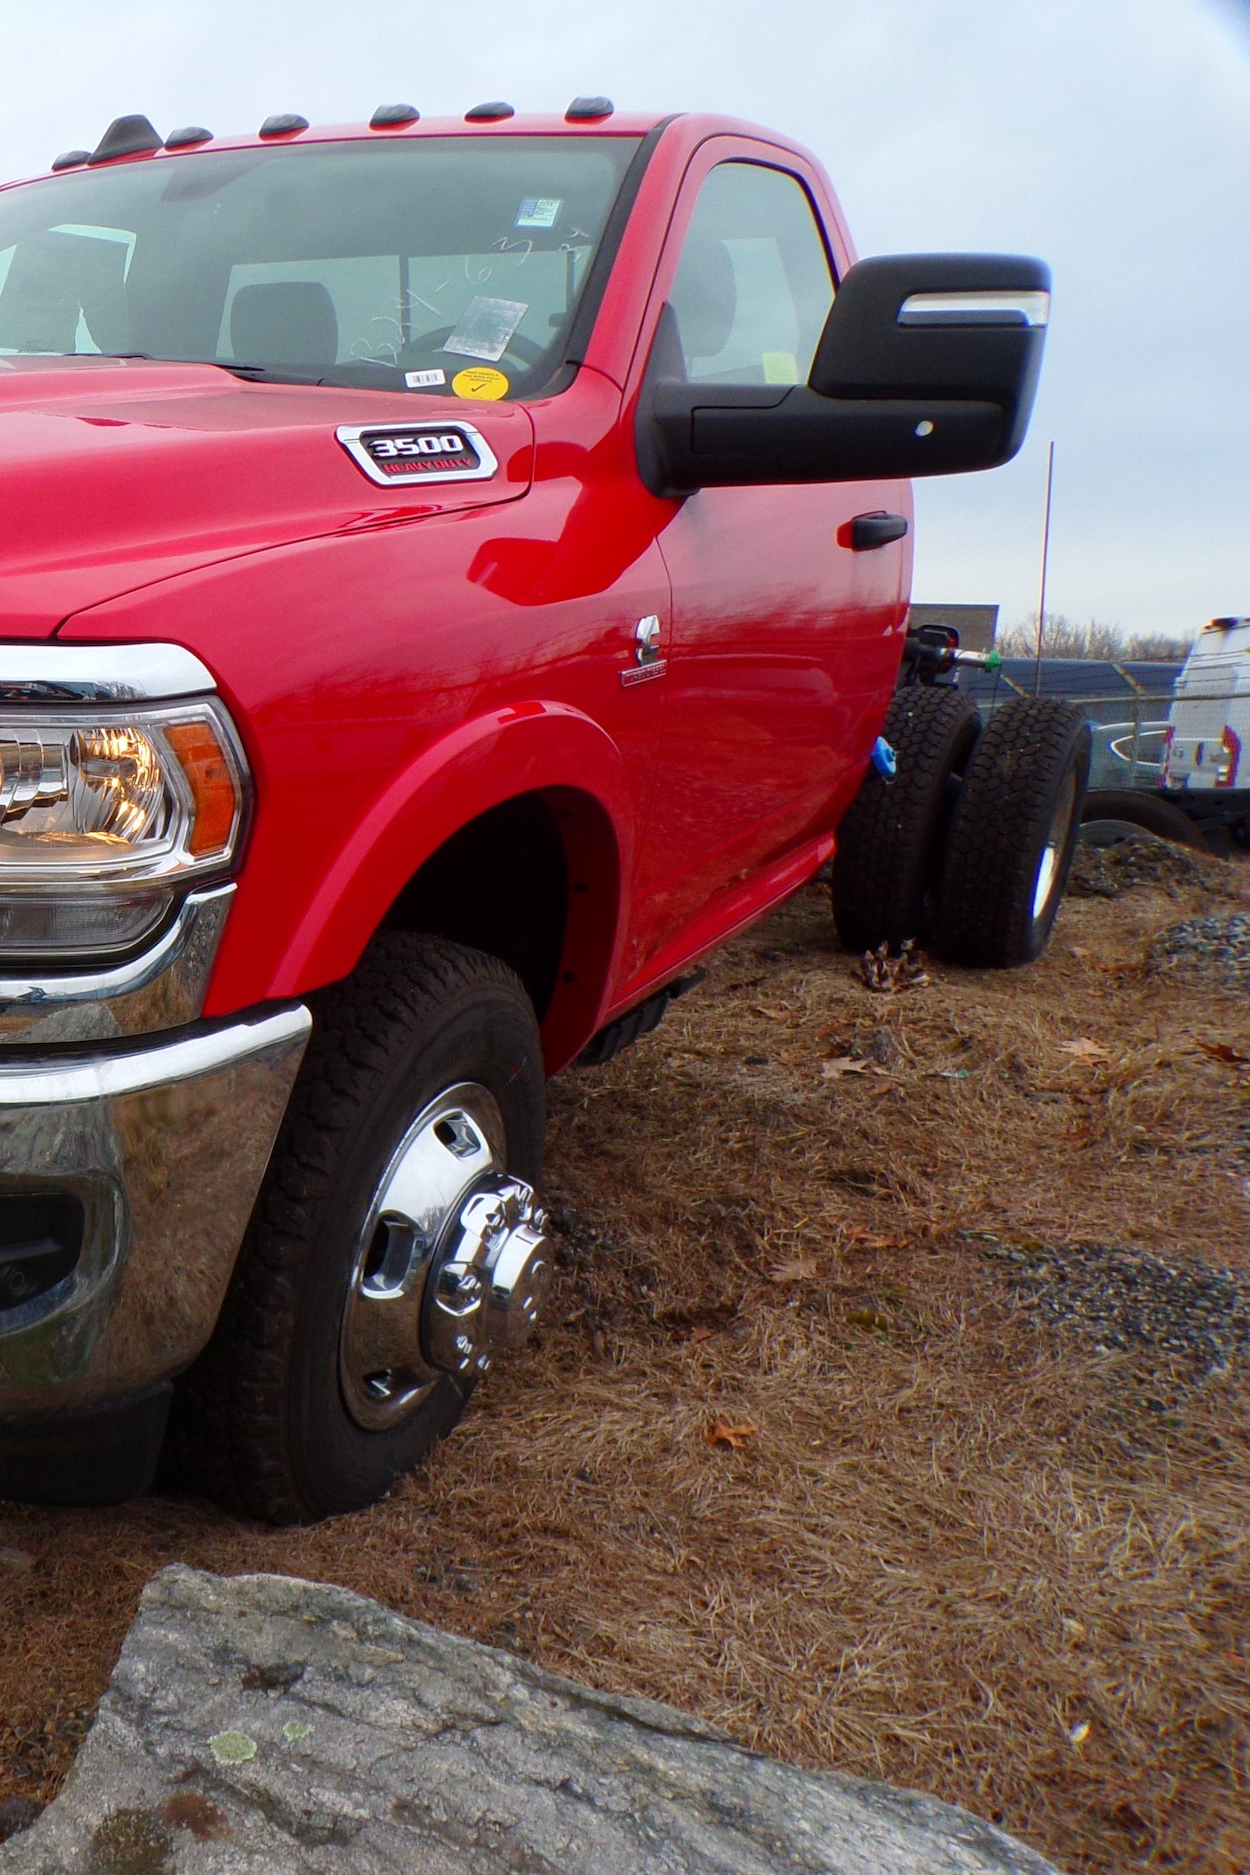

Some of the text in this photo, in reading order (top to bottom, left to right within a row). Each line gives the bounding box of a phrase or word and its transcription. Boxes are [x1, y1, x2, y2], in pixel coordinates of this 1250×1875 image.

[370, 435, 464, 458] 3500
[384, 458, 472, 473] HEAVY DUTY
